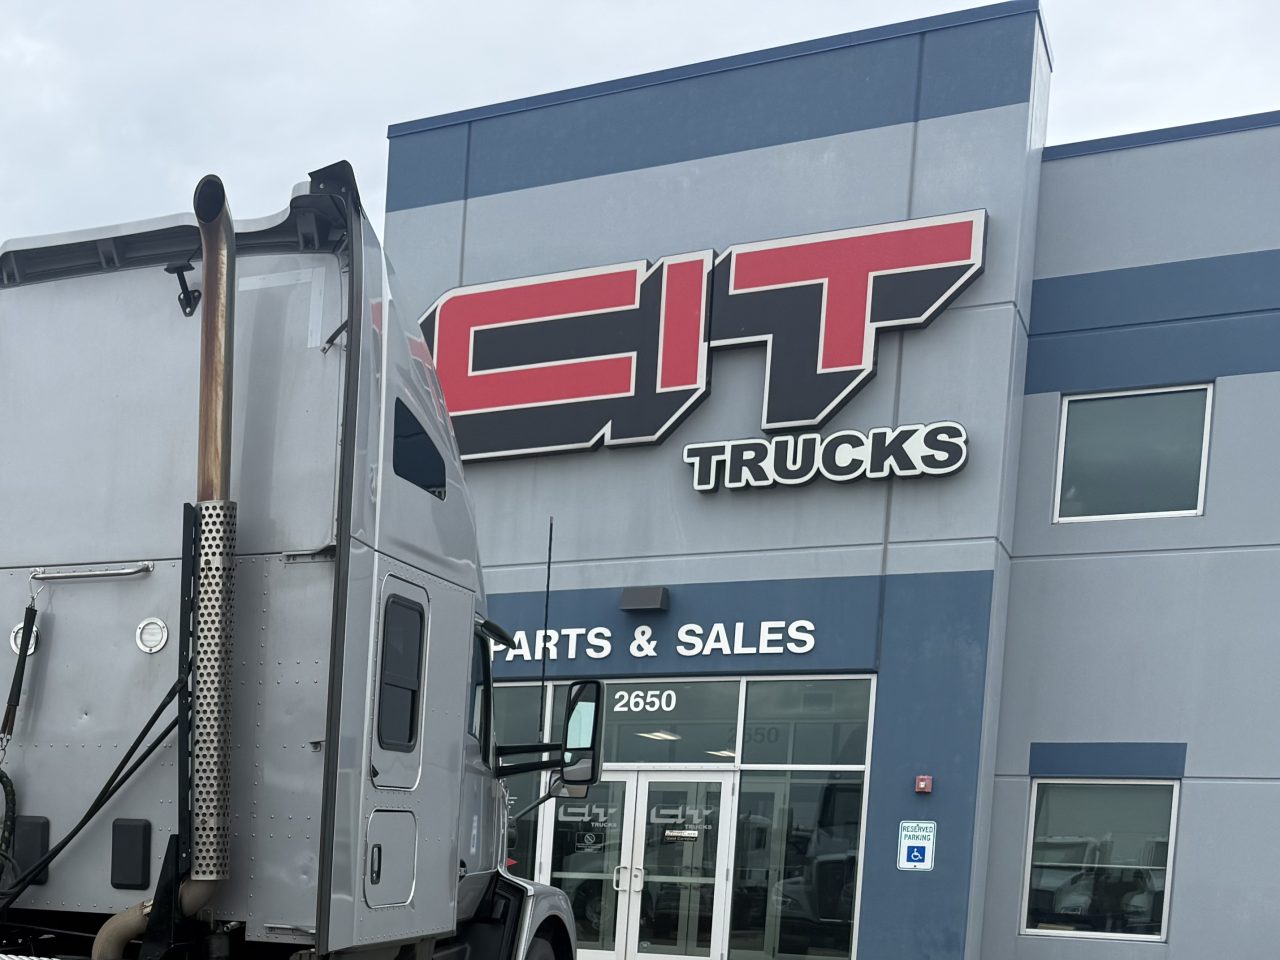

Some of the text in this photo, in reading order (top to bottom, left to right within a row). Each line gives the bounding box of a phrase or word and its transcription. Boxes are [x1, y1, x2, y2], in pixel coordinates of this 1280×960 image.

[419, 208, 987, 461] CIT
[683, 419, 969, 492] TRUCKS
[629, 625, 658, 658] &
[676, 620, 816, 657] SALES
[613, 690, 677, 712] 2650
[903, 825, 933, 833] RESERVED
